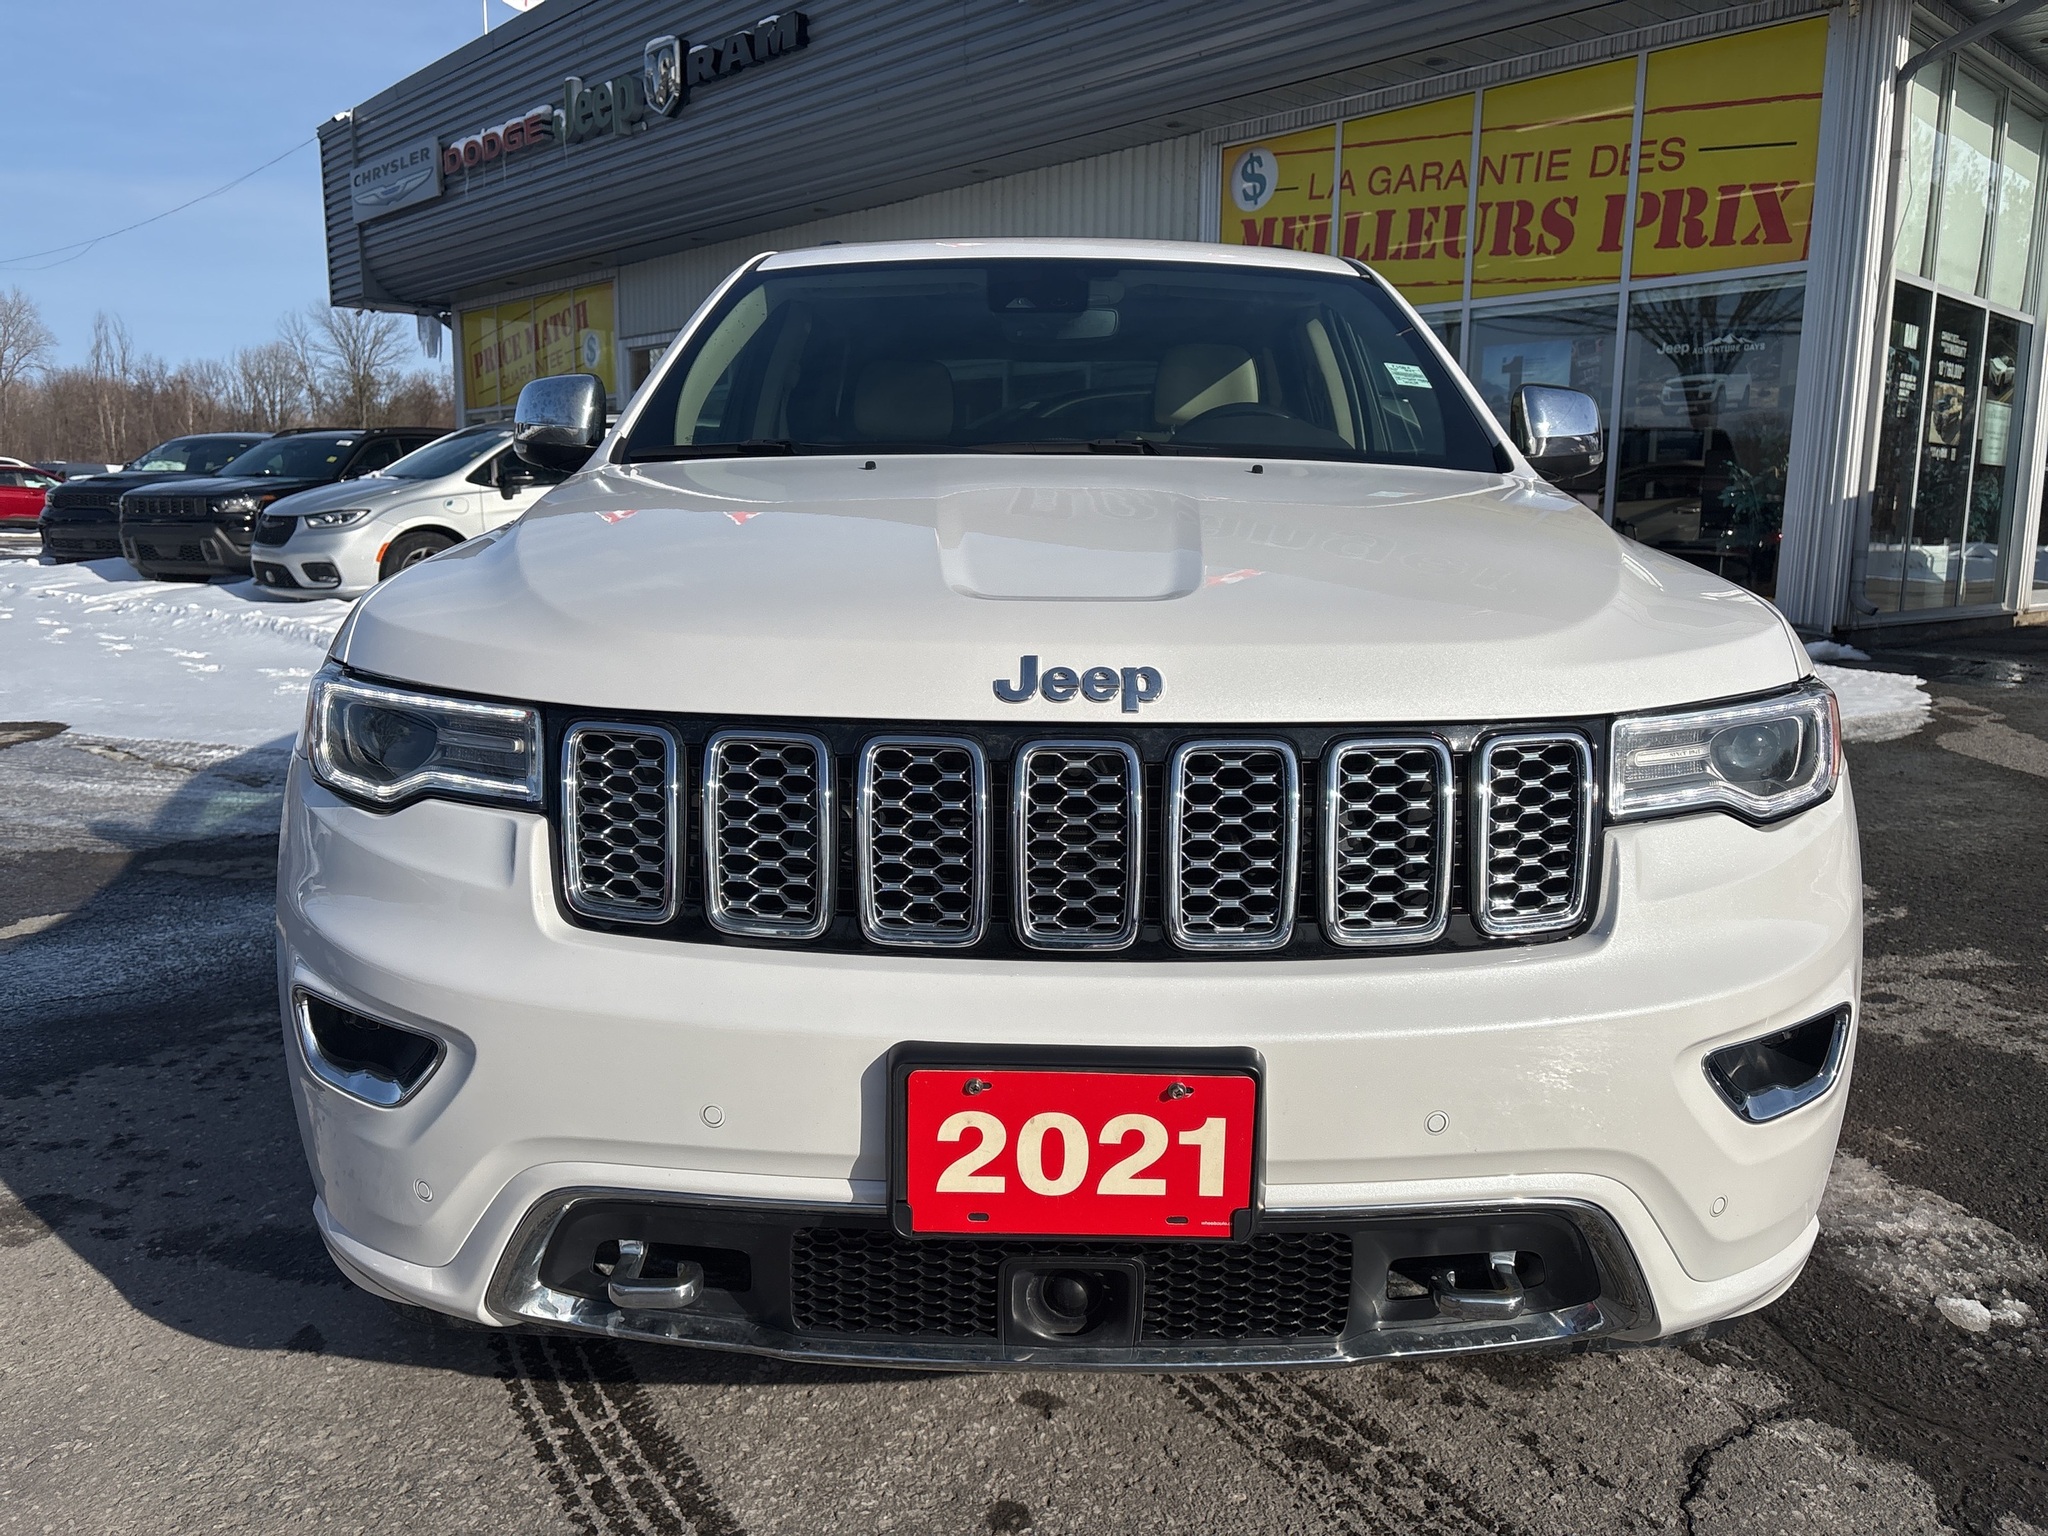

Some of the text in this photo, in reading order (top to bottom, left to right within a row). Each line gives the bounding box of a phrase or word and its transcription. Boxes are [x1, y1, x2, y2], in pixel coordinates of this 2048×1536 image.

[686, 10, 803, 88] RAM
[552, 75, 643, 142] Jeep
[353, 146, 431, 188] CHRYSLER
[443, 113, 547, 176] DODGE
[1308, 136, 1687, 201] LA GARANTIE DES
[1240, 180, 1800, 262] MEILLEURS PRIX
[474, 300, 589, 380] PRICE MATCH
[501, 348, 565, 391] GUARANTEE
[1656, 341, 1766, 355] Jeep ADVENTURE DAYS
[993, 654, 1163, 713] Jeep
[935, 1110, 1227, 1197] 2021
